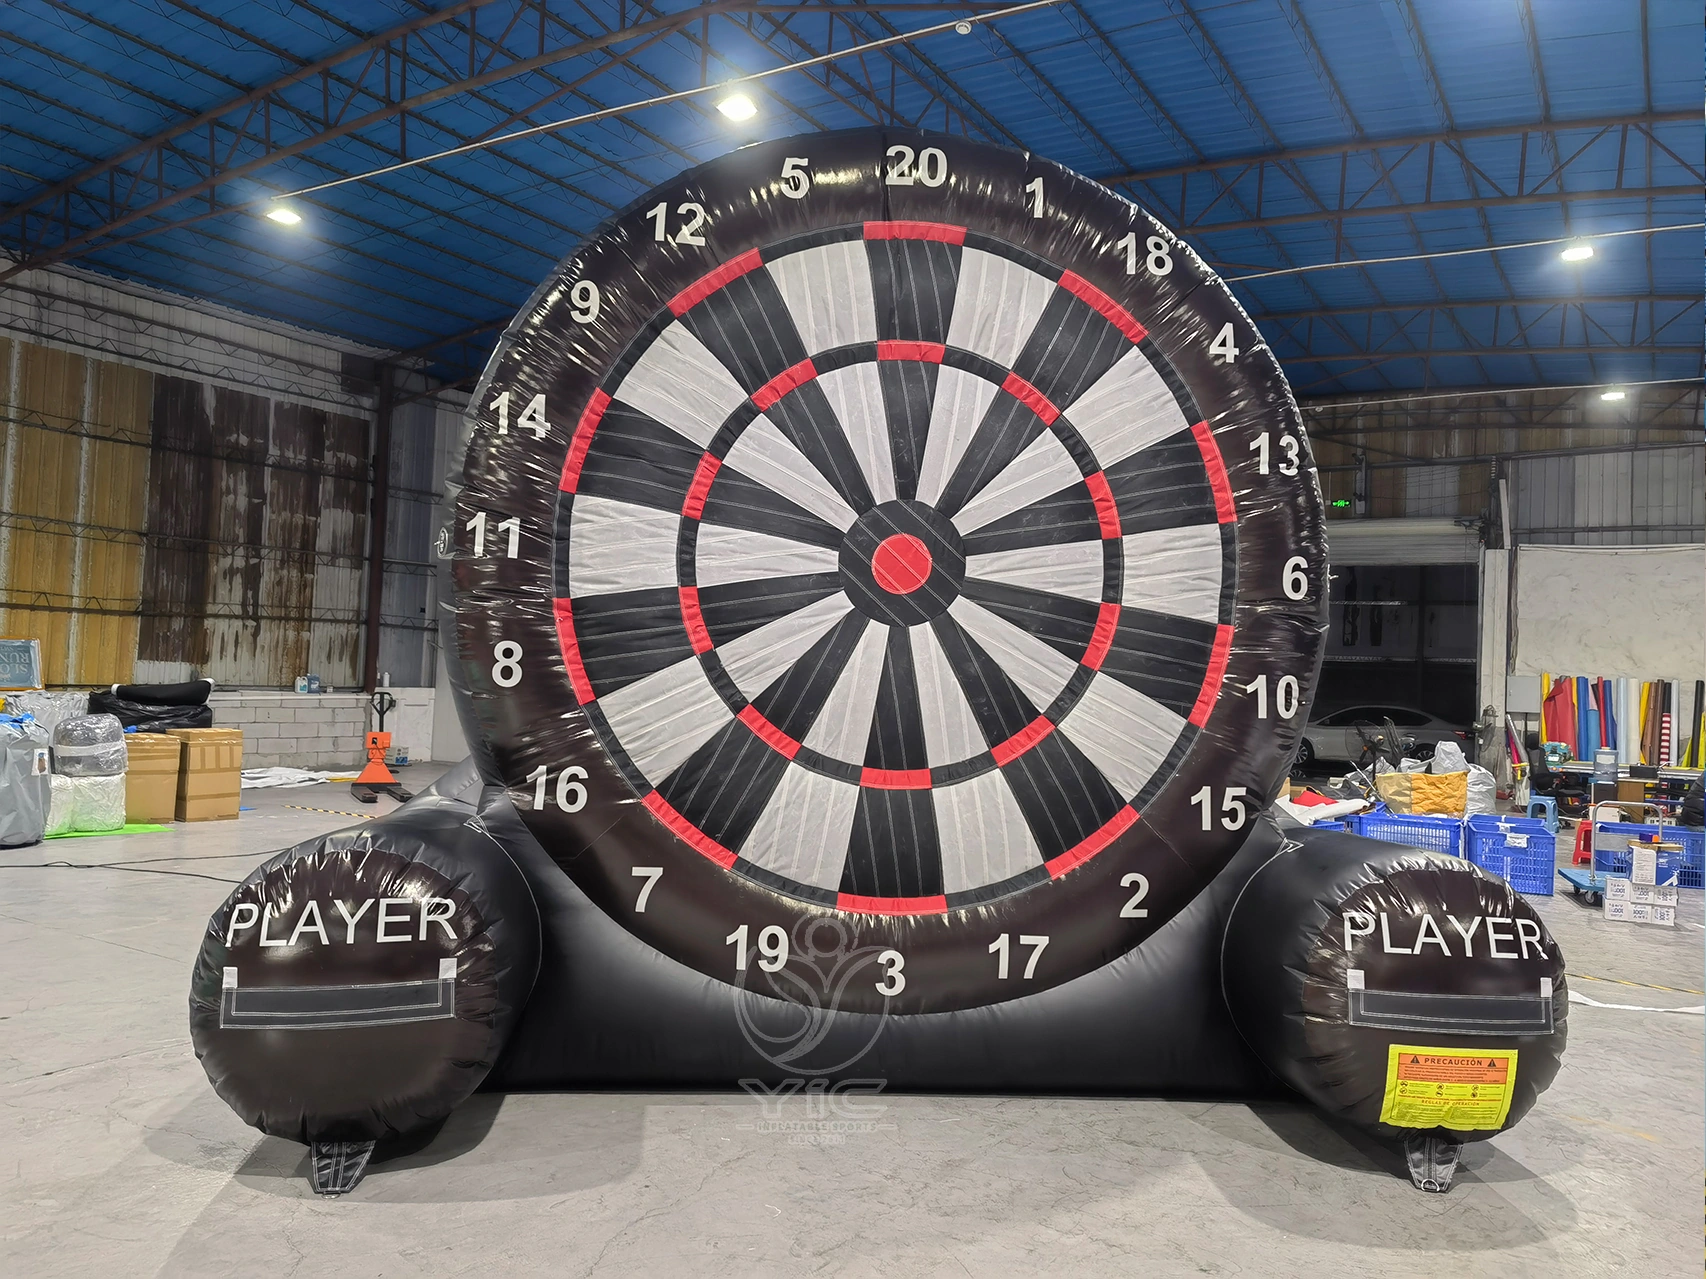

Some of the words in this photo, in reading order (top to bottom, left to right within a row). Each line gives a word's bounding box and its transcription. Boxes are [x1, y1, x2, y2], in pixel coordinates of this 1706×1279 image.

[779, 158, 810, 199] 5
[886, 146, 948, 188] 20
[1026, 178, 1044, 218] 1
[646, 203, 712, 247] 12
[1117, 232, 1174, 276] 18
[570, 280, 600, 324] 9
[1209, 323, 1240, 364] 4
[489, 392, 552, 440] 14
[1249, 432, 1300, 476] 13
[466, 511, 521, 559] 11
[1283, 556, 1309, 601] 6
[492, 641, 523, 688] 8
[1247, 675, 1299, 720] 10
[526, 765, 589, 813] 16
[1190, 786, 1247, 831] 15
[632, 867, 664, 912] 7
[1120, 873, 1149, 918] 2
[225, 898, 458, 948] PLAYER
[1343, 911, 1549, 960] PLAYER
[726, 925, 789, 972] 19
[989, 934, 1050, 980] 17
[875, 949, 906, 996] 3
[1424, 1057, 1482, 1066] PRECAUCIÓN
